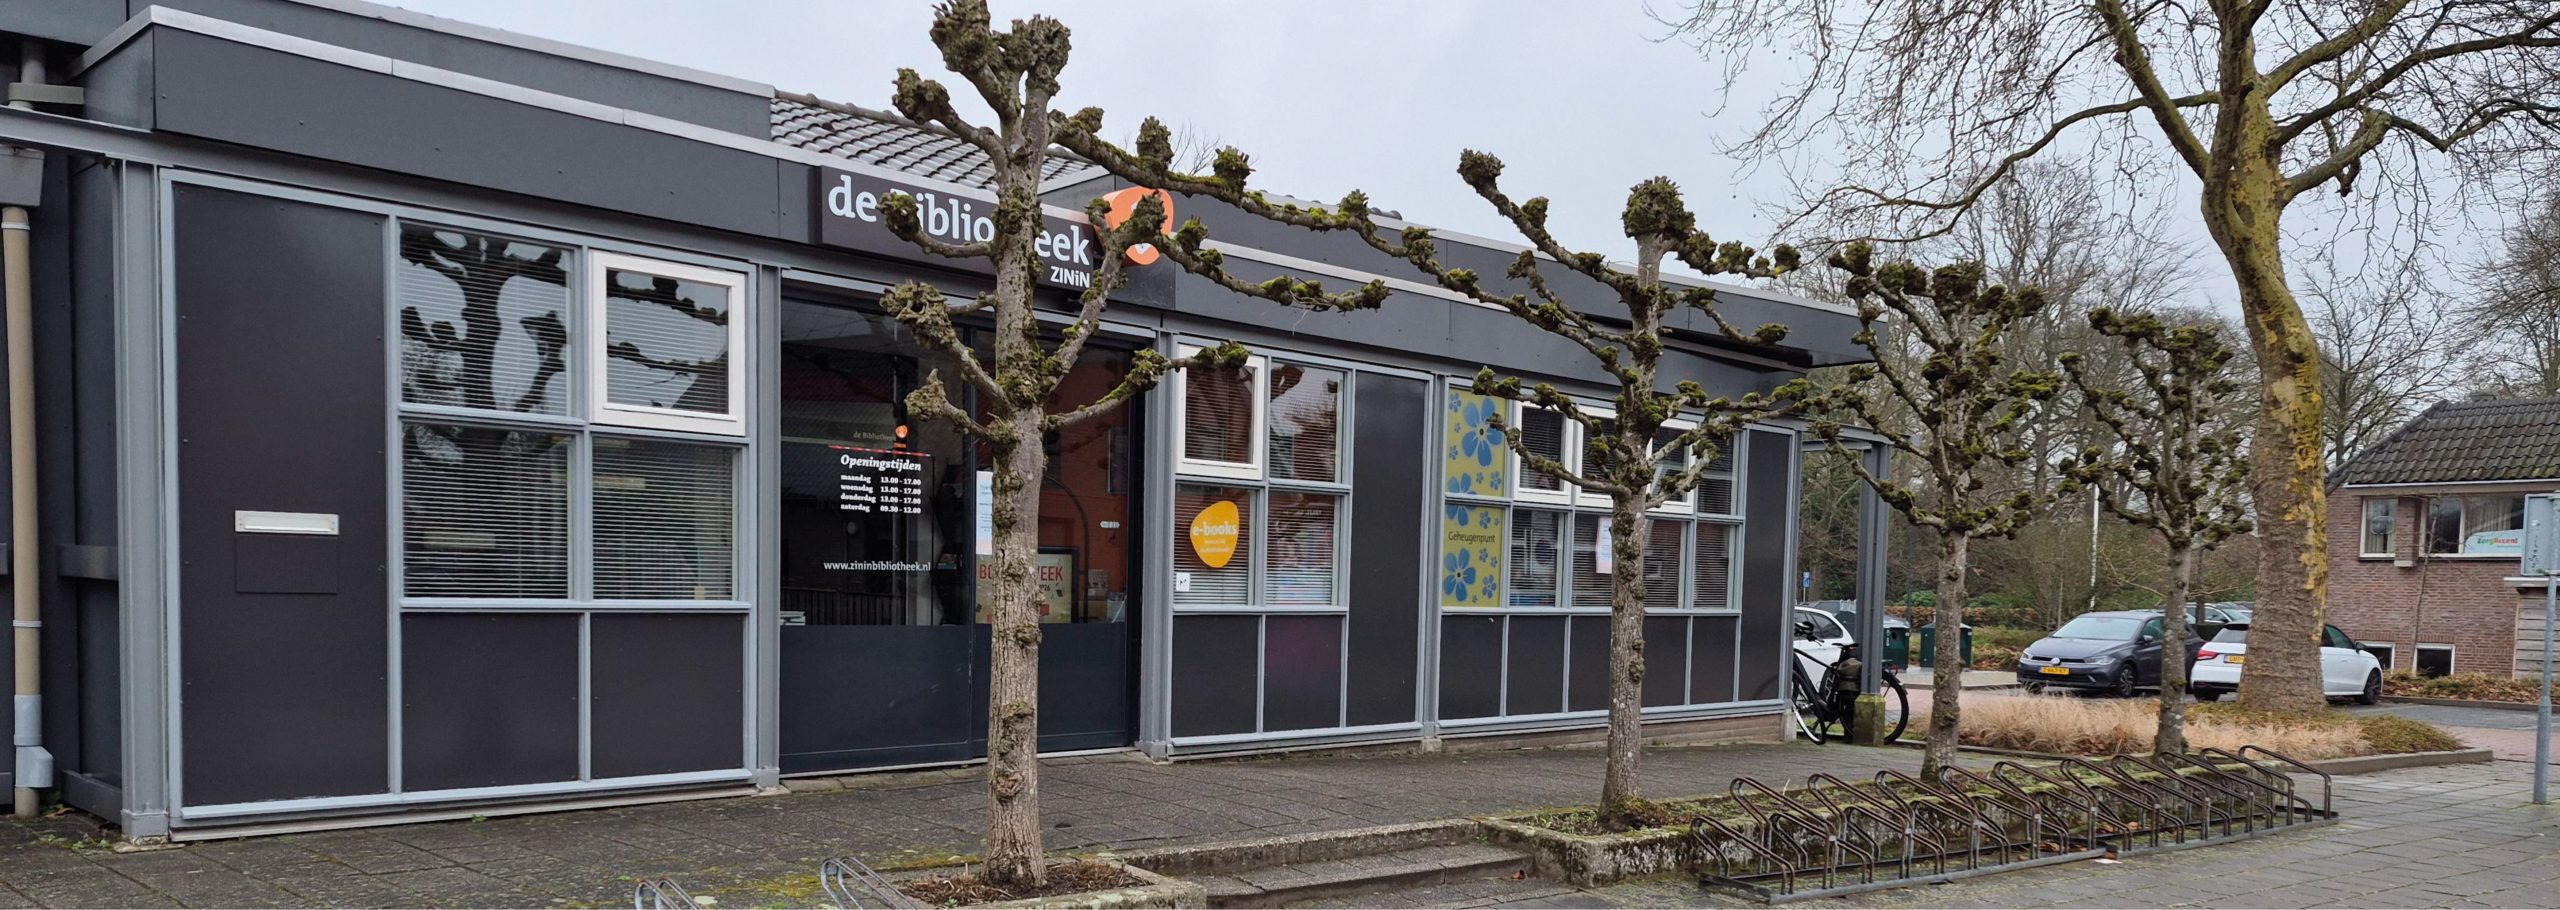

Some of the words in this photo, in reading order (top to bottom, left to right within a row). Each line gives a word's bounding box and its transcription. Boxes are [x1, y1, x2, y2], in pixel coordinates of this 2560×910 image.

[828, 174, 877, 223] de
[890, 188, 1090, 266] iblioeek
[1050, 265, 1090, 288] ZINiN
[840, 454, 921, 472] Openingstijden
[840, 474, 871, 483] maandag
[840, 484, 873, 493] woensdag
[840, 492, 876, 503] donderdag
[840, 503, 870, 512] zaterdag
[880, 505, 898, 513] 09.30
[1192, 521, 1237, 536] e-books
[1448, 531, 1495, 544] Geheugenpunt
[823, 560, 931, 571] www.zininbibliotheek.nl
